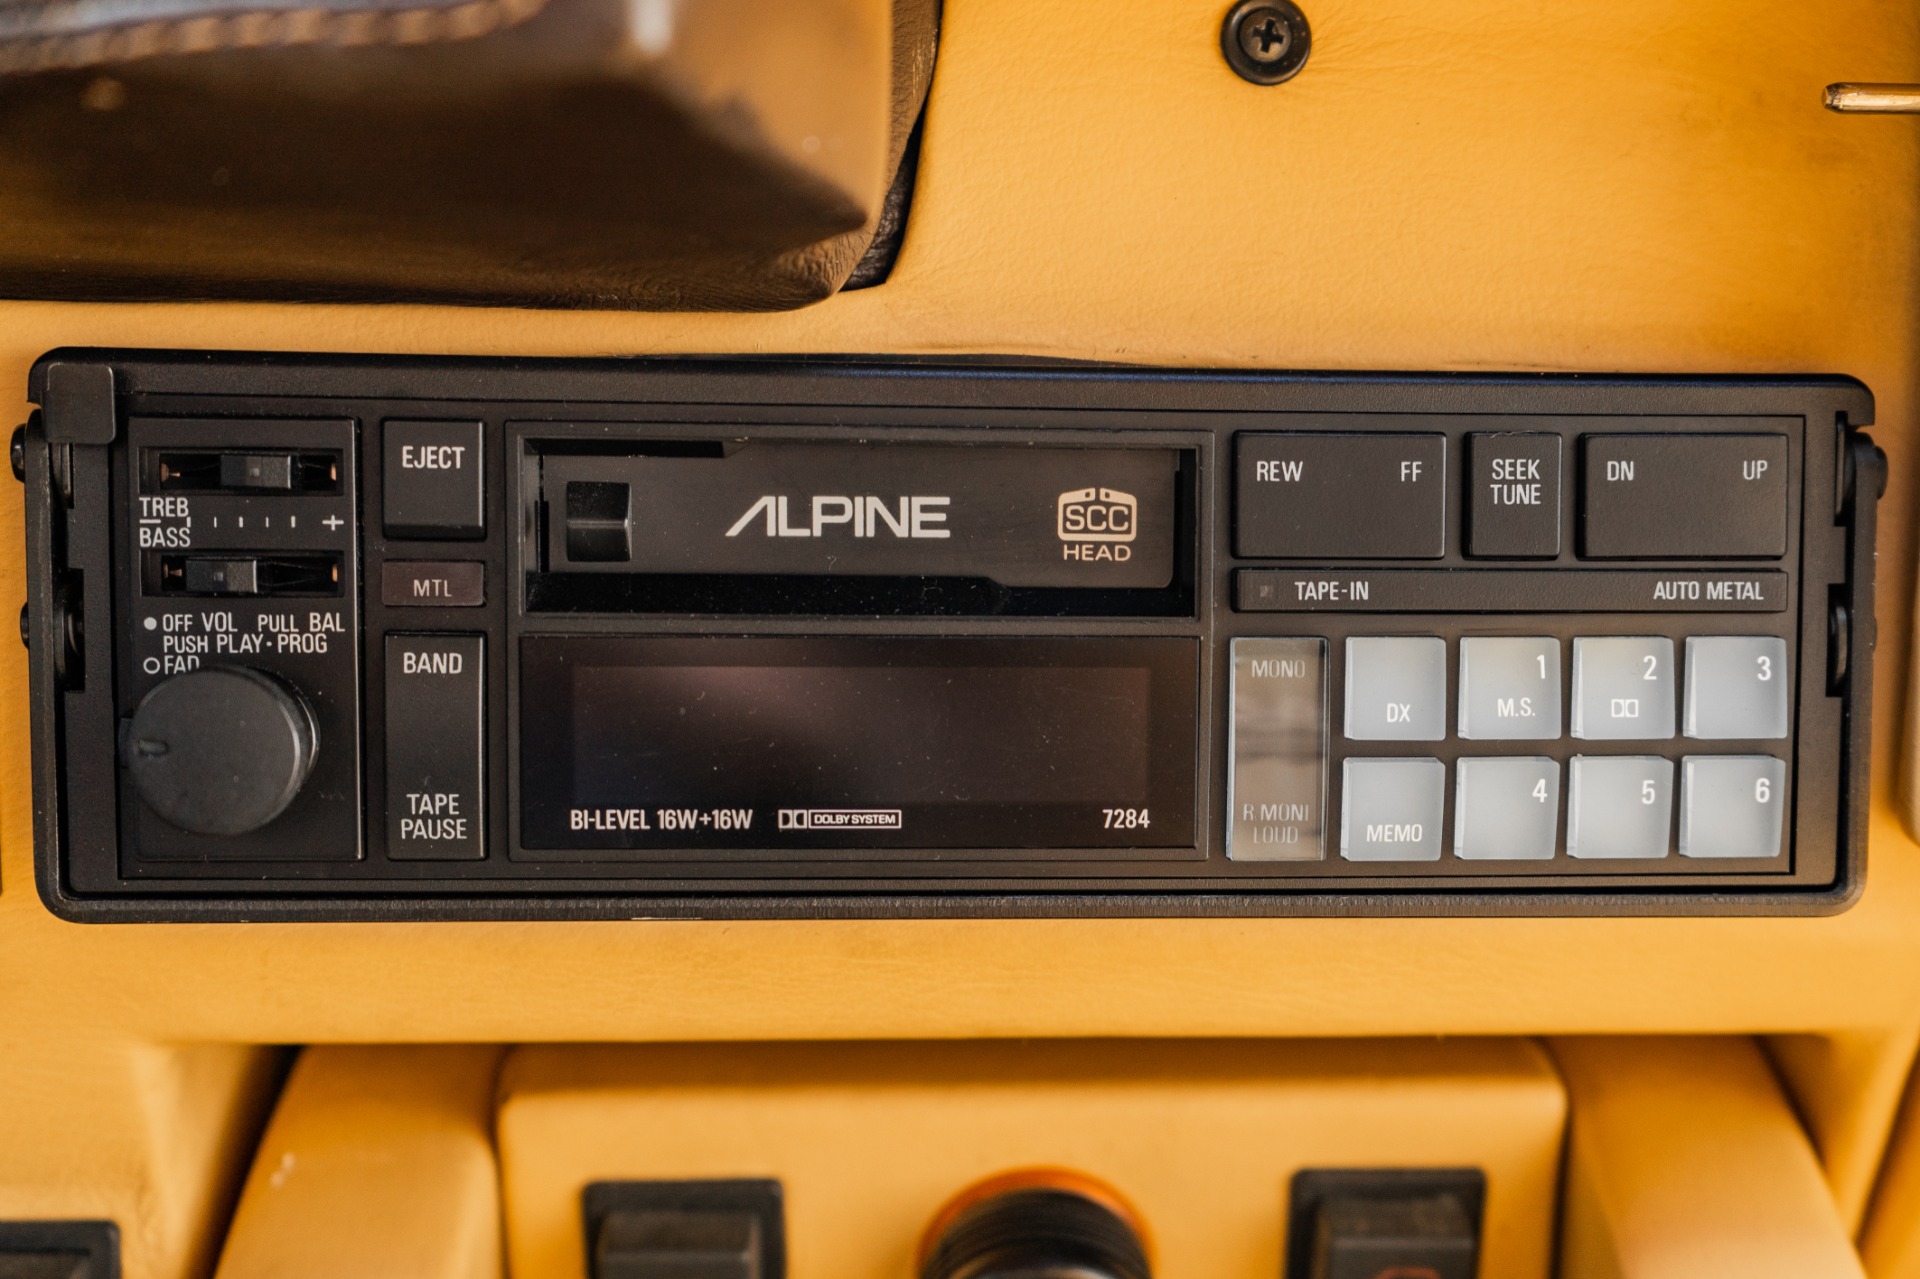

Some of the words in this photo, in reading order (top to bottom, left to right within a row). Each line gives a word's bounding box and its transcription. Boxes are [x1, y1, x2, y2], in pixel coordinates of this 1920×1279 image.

[402, 445, 466, 469] EJECT
[1256, 460, 1304, 482] REW
[1400, 461, 1422, 482] FF
[1491, 458, 1540, 480] SEEK
[1607, 460, 1634, 482] DN
[1742, 459, 1768, 481] UP
[1489, 483, 1542, 505] TUNE
[138, 496, 190, 518] TREB
[725, 495, 951, 539] ALPINE
[1065, 505, 1129, 531] SCC
[138, 526, 191, 548] BASS
[1063, 544, 1131, 562] HEAD
[413, 579, 452, 598] MTL
[1294, 580, 1369, 601] TAPE-IN
[1653, 580, 1700, 601] AUTO
[1706, 580, 1764, 601] METAL
[162, 613, 193, 632] OFF
[201, 611, 238, 632] VOL
[257, 614, 300, 633] PULL
[309, 612, 345, 632] BAL
[163, 635, 209, 654] PUSH
[403, 651, 463, 674] BAND
[1251, 658, 1306, 678] MONO
[1536, 654, 1546, 680] 1
[1642, 655, 1658, 681] 2
[1756, 655, 1772, 681] 3
[1386, 702, 1411, 723] DX
[1497, 697, 1537, 718] M.S.
[1532, 778, 1548, 803] 4
[1640, 779, 1656, 805] 5
[1754, 777, 1770, 803] 6
[406, 793, 460, 815] TAPE
[1260, 803, 1309, 822] MONI
[401, 818, 467, 840] PAUSE
[570, 809, 651, 830] BI-LEVEL
[656, 809, 753, 830] 16W+16W
[813, 813, 849, 825] DOLBY
[850, 813, 897, 825] SYSTEM
[1102, 808, 1151, 829] 7284
[1253, 825, 1300, 845] LOUD
[1365, 823, 1424, 844] MEMO
